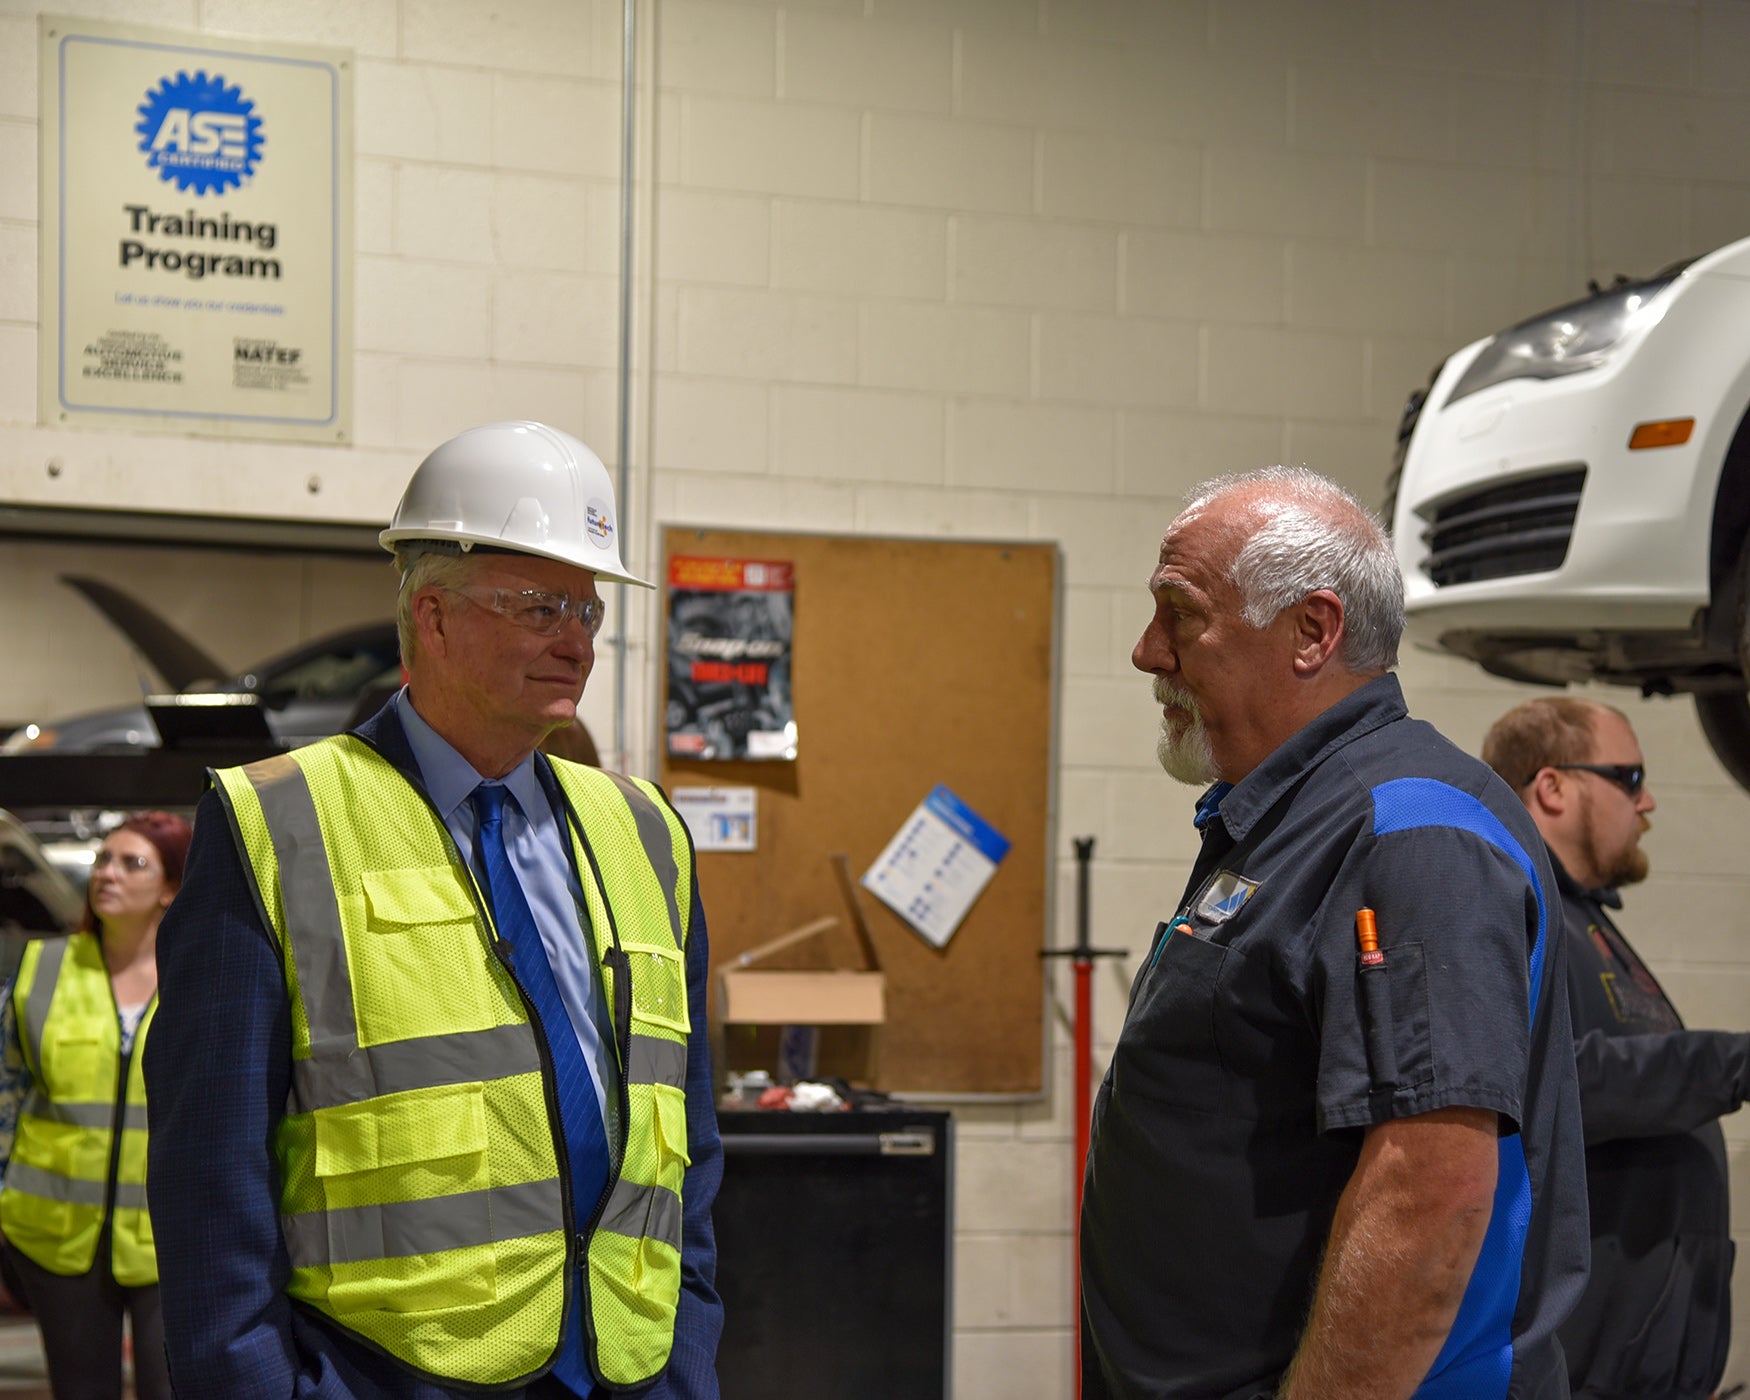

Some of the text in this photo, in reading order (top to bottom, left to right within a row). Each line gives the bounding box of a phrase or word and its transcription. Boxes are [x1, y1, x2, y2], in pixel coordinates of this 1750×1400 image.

[151, 108, 247, 157] ASE
[124, 205, 277, 249] Training
[119, 240, 281, 279] Program
